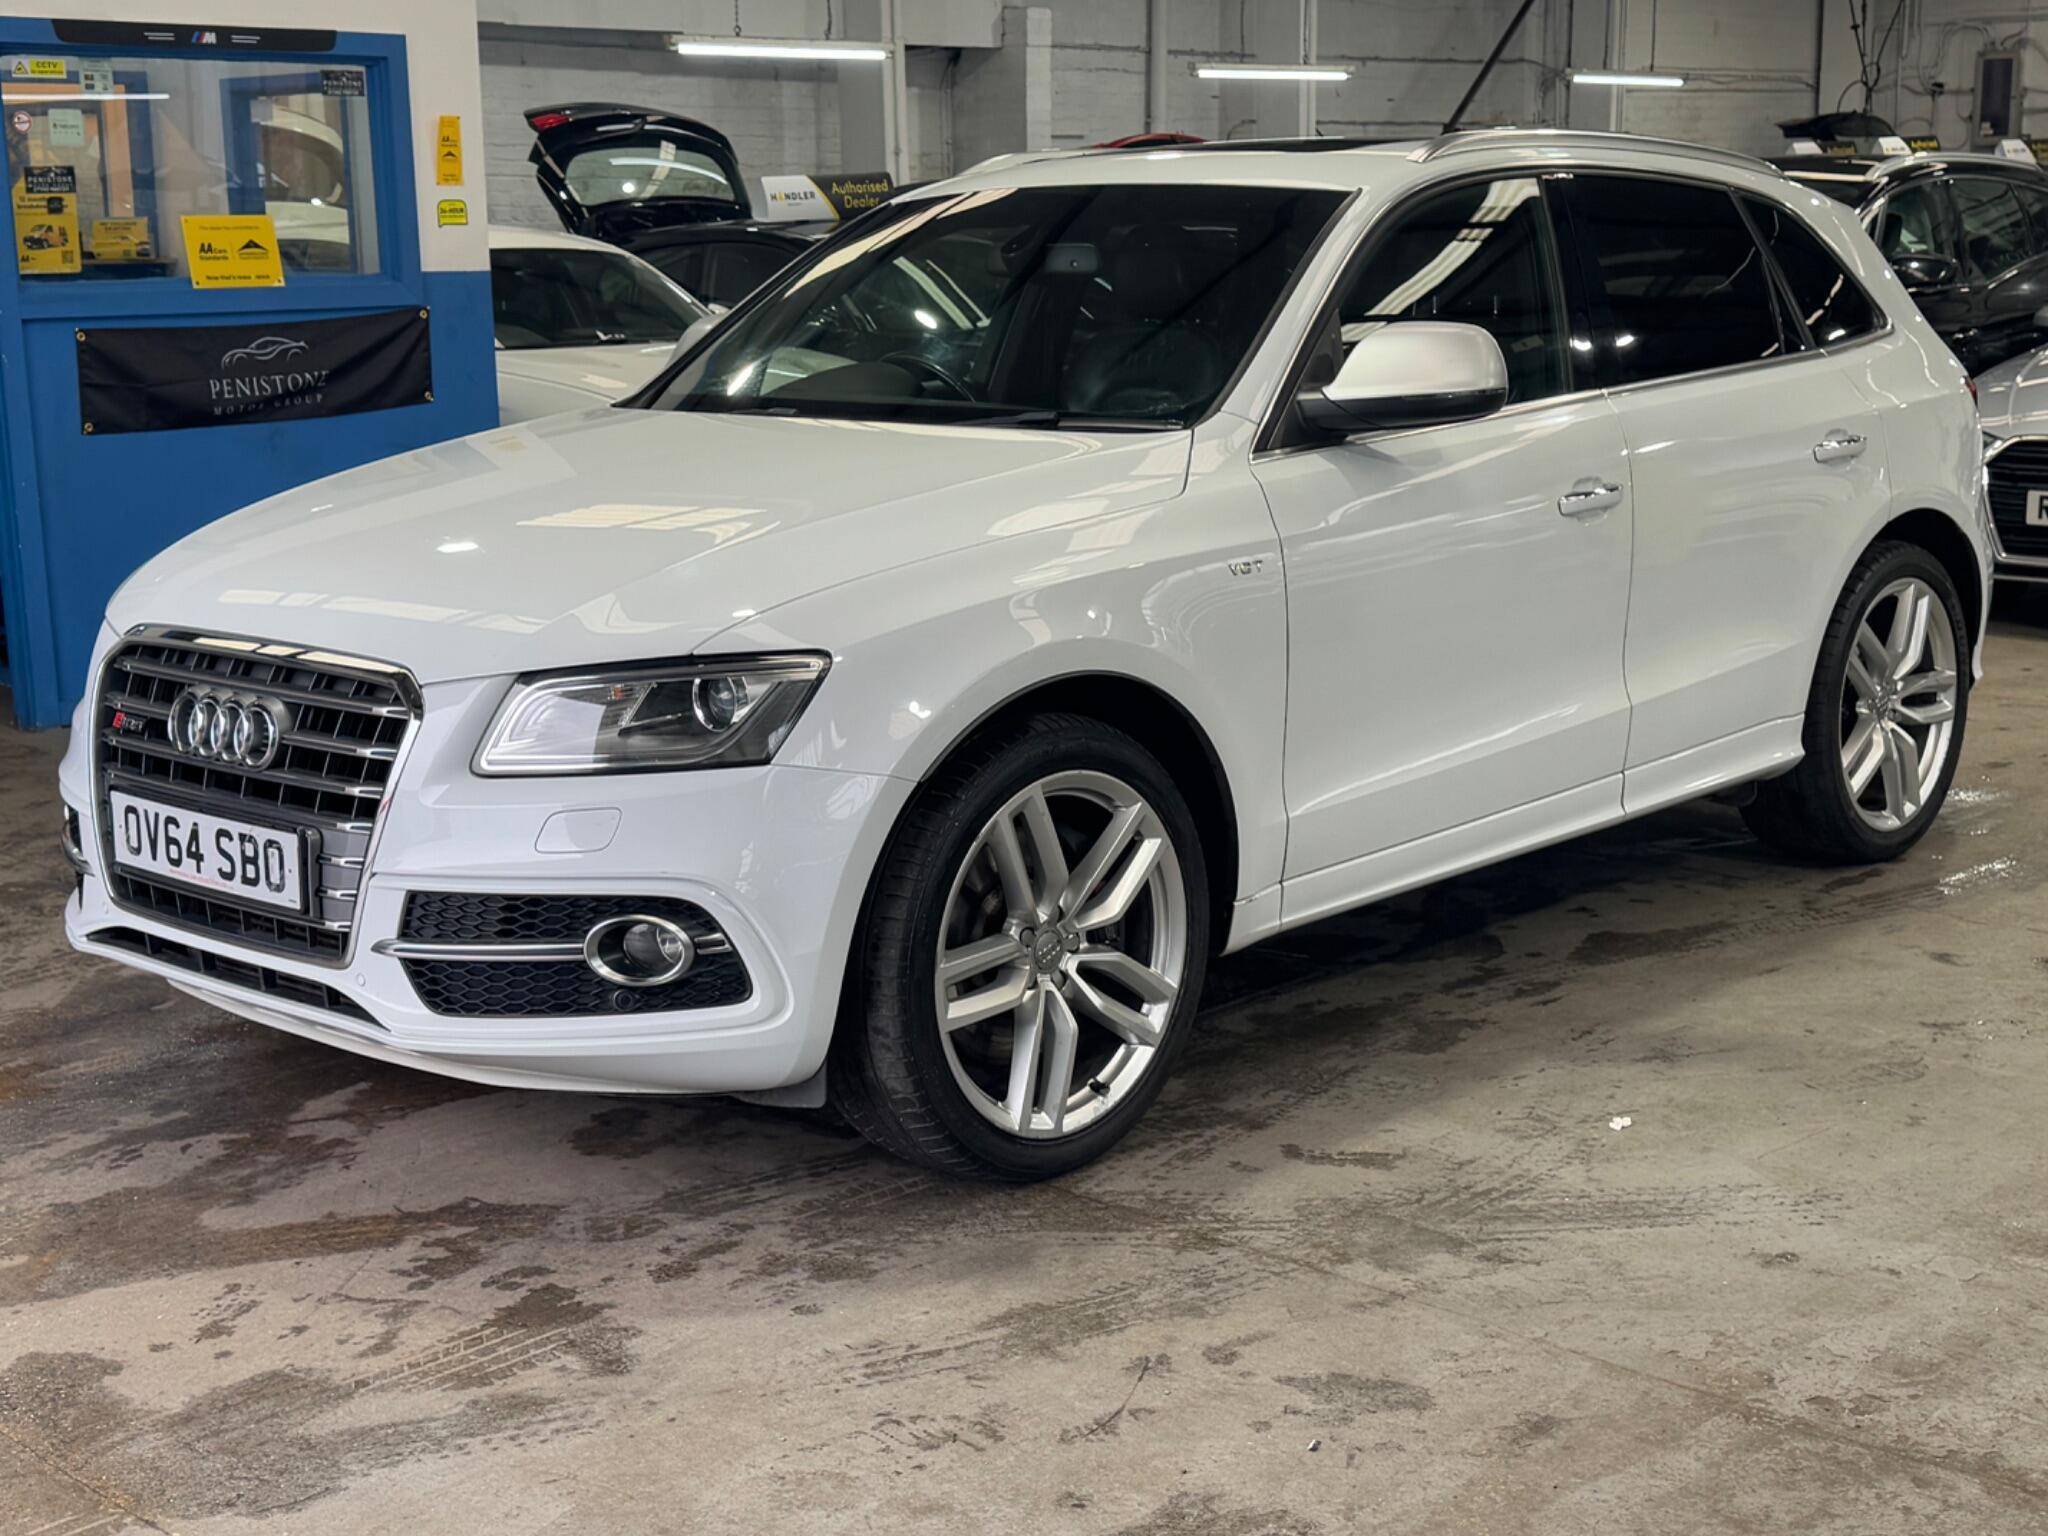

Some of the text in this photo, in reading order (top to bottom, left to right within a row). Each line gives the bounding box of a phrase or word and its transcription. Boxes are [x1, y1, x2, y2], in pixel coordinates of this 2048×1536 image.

[35, 60, 59, 69] CCTV
[831, 179, 889, 194] Authorised
[843, 195, 880, 209] Dealer
[199, 242, 213, 254] AA
[209, 369, 330, 400] PENISTONE
[123, 804, 205, 874] OV64
